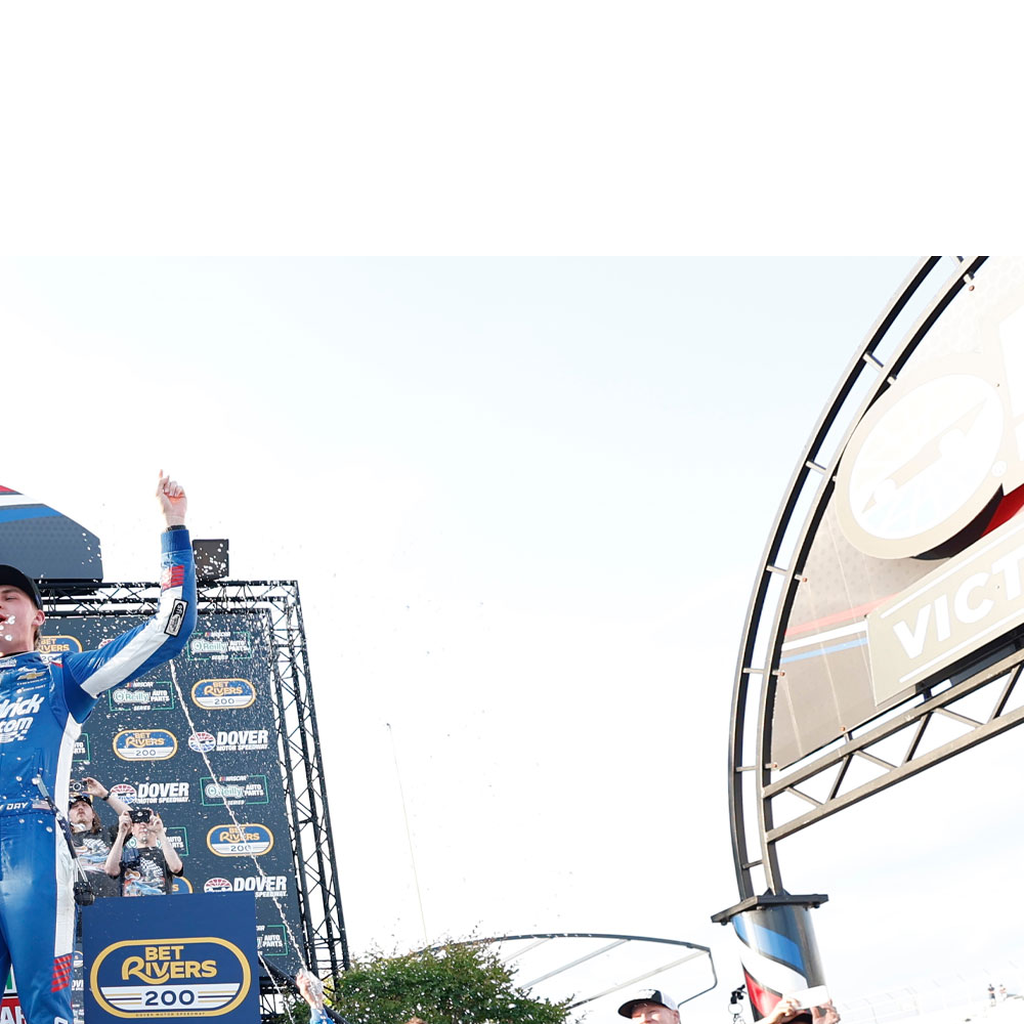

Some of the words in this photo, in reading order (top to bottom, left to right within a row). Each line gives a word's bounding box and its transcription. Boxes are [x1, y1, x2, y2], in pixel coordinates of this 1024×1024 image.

[204, 686, 243, 696] RIVERS
[126, 737, 165, 748] RIVERS
[216, 730, 268, 745] DOVER
[138, 782, 190, 797] DOVER
[234, 876, 288, 891] DOVER
[145, 945, 185, 961] BET
[121, 955, 218, 985] RIVERS
[145, 989, 196, 1006] 200
